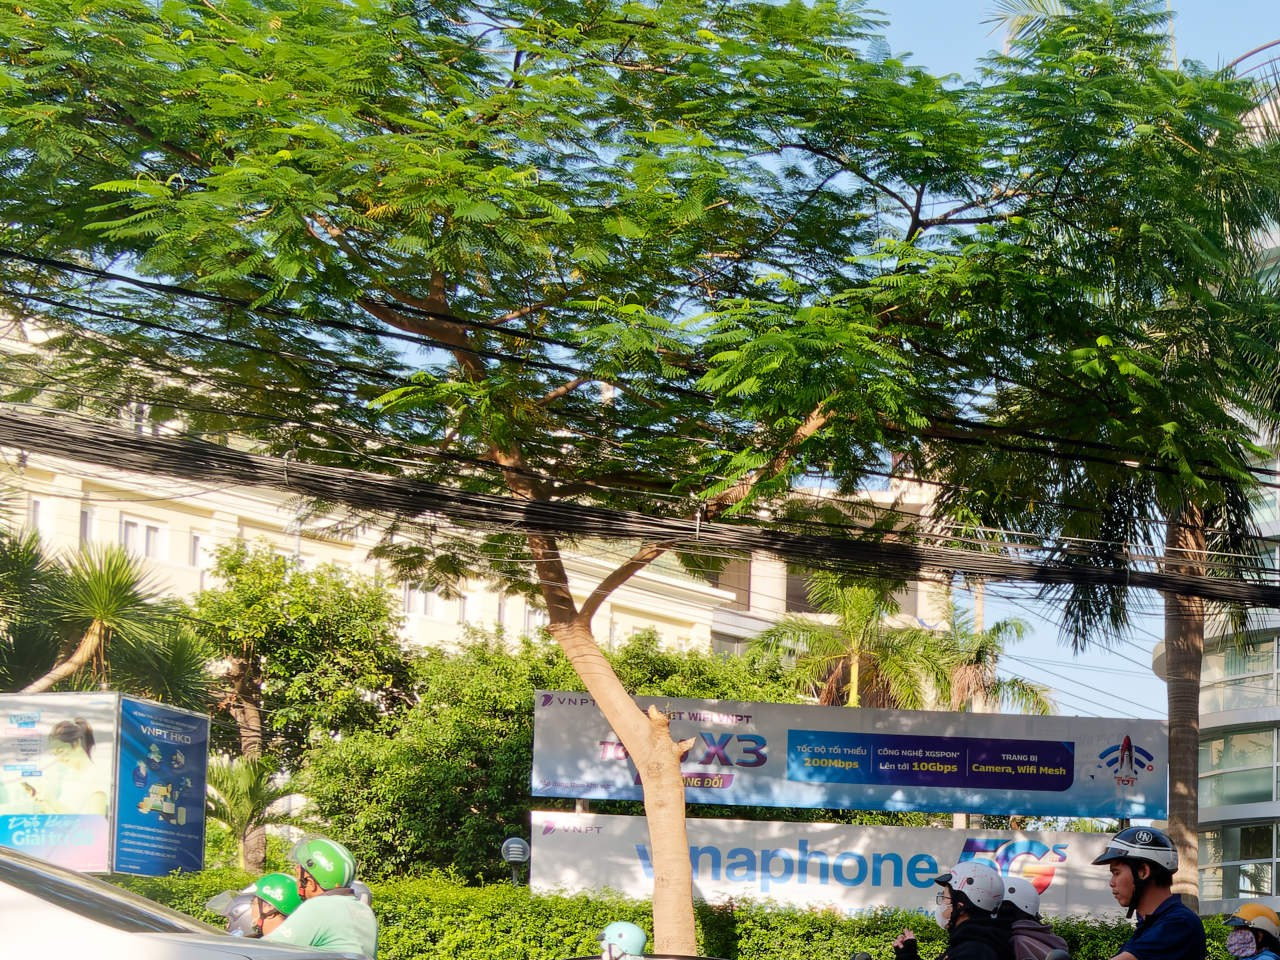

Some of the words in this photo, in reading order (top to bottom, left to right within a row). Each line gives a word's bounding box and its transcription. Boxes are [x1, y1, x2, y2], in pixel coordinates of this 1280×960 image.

[688, 711, 713, 722] WIFI
[716, 713, 752, 724] VNPT
[141, 725, 168, 739] VNPT
[170, 731, 192, 745] HKD
[698, 731, 768, 767] X3
[877, 748, 899, 757] CÔNG
[901, 749, 923, 758] NGHỆ
[803, 757, 859, 769] 200Mbps
[879, 762, 895, 770] Lên
[912, 761, 958, 773] 10Gbps
[972, 763, 1015, 775] Camera,
[1017, 765, 1038, 774] Wifi
[1040, 766, 1066, 776] Mesh
[12, 827, 46, 846] Giải
[562, 826, 603, 834] VNPT
